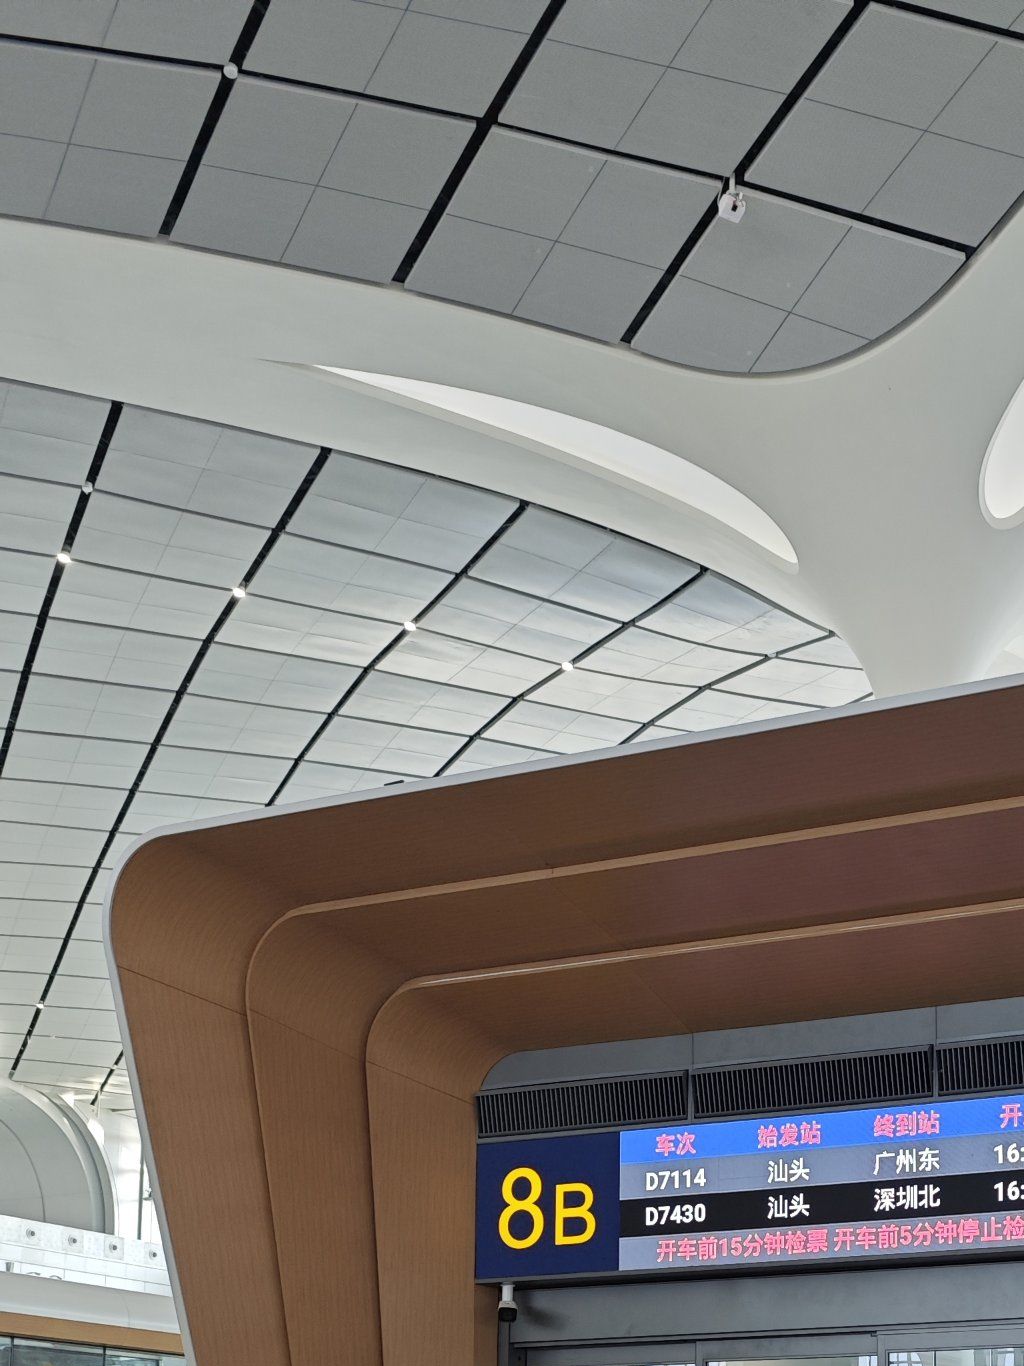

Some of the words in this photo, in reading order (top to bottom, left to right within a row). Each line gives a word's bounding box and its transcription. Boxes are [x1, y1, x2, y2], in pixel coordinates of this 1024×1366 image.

[655, 1131, 696, 1157] 车次
[757, 1120, 822, 1148] 始发站
[874, 1110, 940, 1136] 终到站
[646, 1169, 706, 1190] D7114
[768, 1158, 809, 1183] 汕头
[873, 1148, 939, 1175] 广州东
[499, 1168, 595, 1249] 8B
[646, 1204, 705, 1225] D7430
[768, 1194, 809, 1219] 汕头
[874, 1185, 940, 1211] 深圳北
[657, 1230, 829, 1263] 开车前15分钟检票
